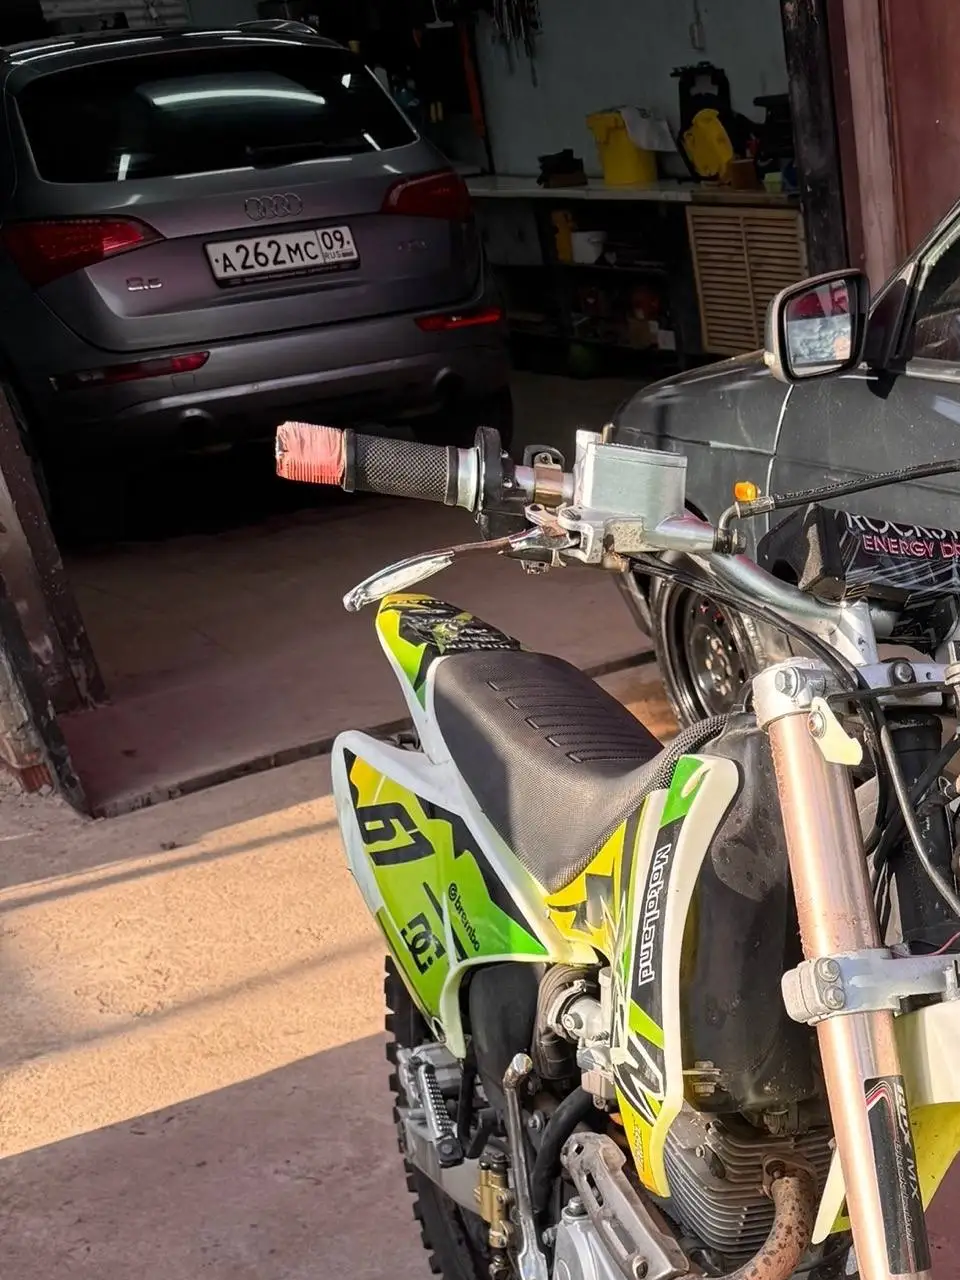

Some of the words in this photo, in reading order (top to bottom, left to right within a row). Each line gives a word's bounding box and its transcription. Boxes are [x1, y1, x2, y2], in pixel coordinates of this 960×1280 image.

[321, 229, 345, 250] 09
[862, 534, 934, 558] ENERGY
[453, 894, 481, 952] brembo
[906, 1157, 921, 1201] MX
